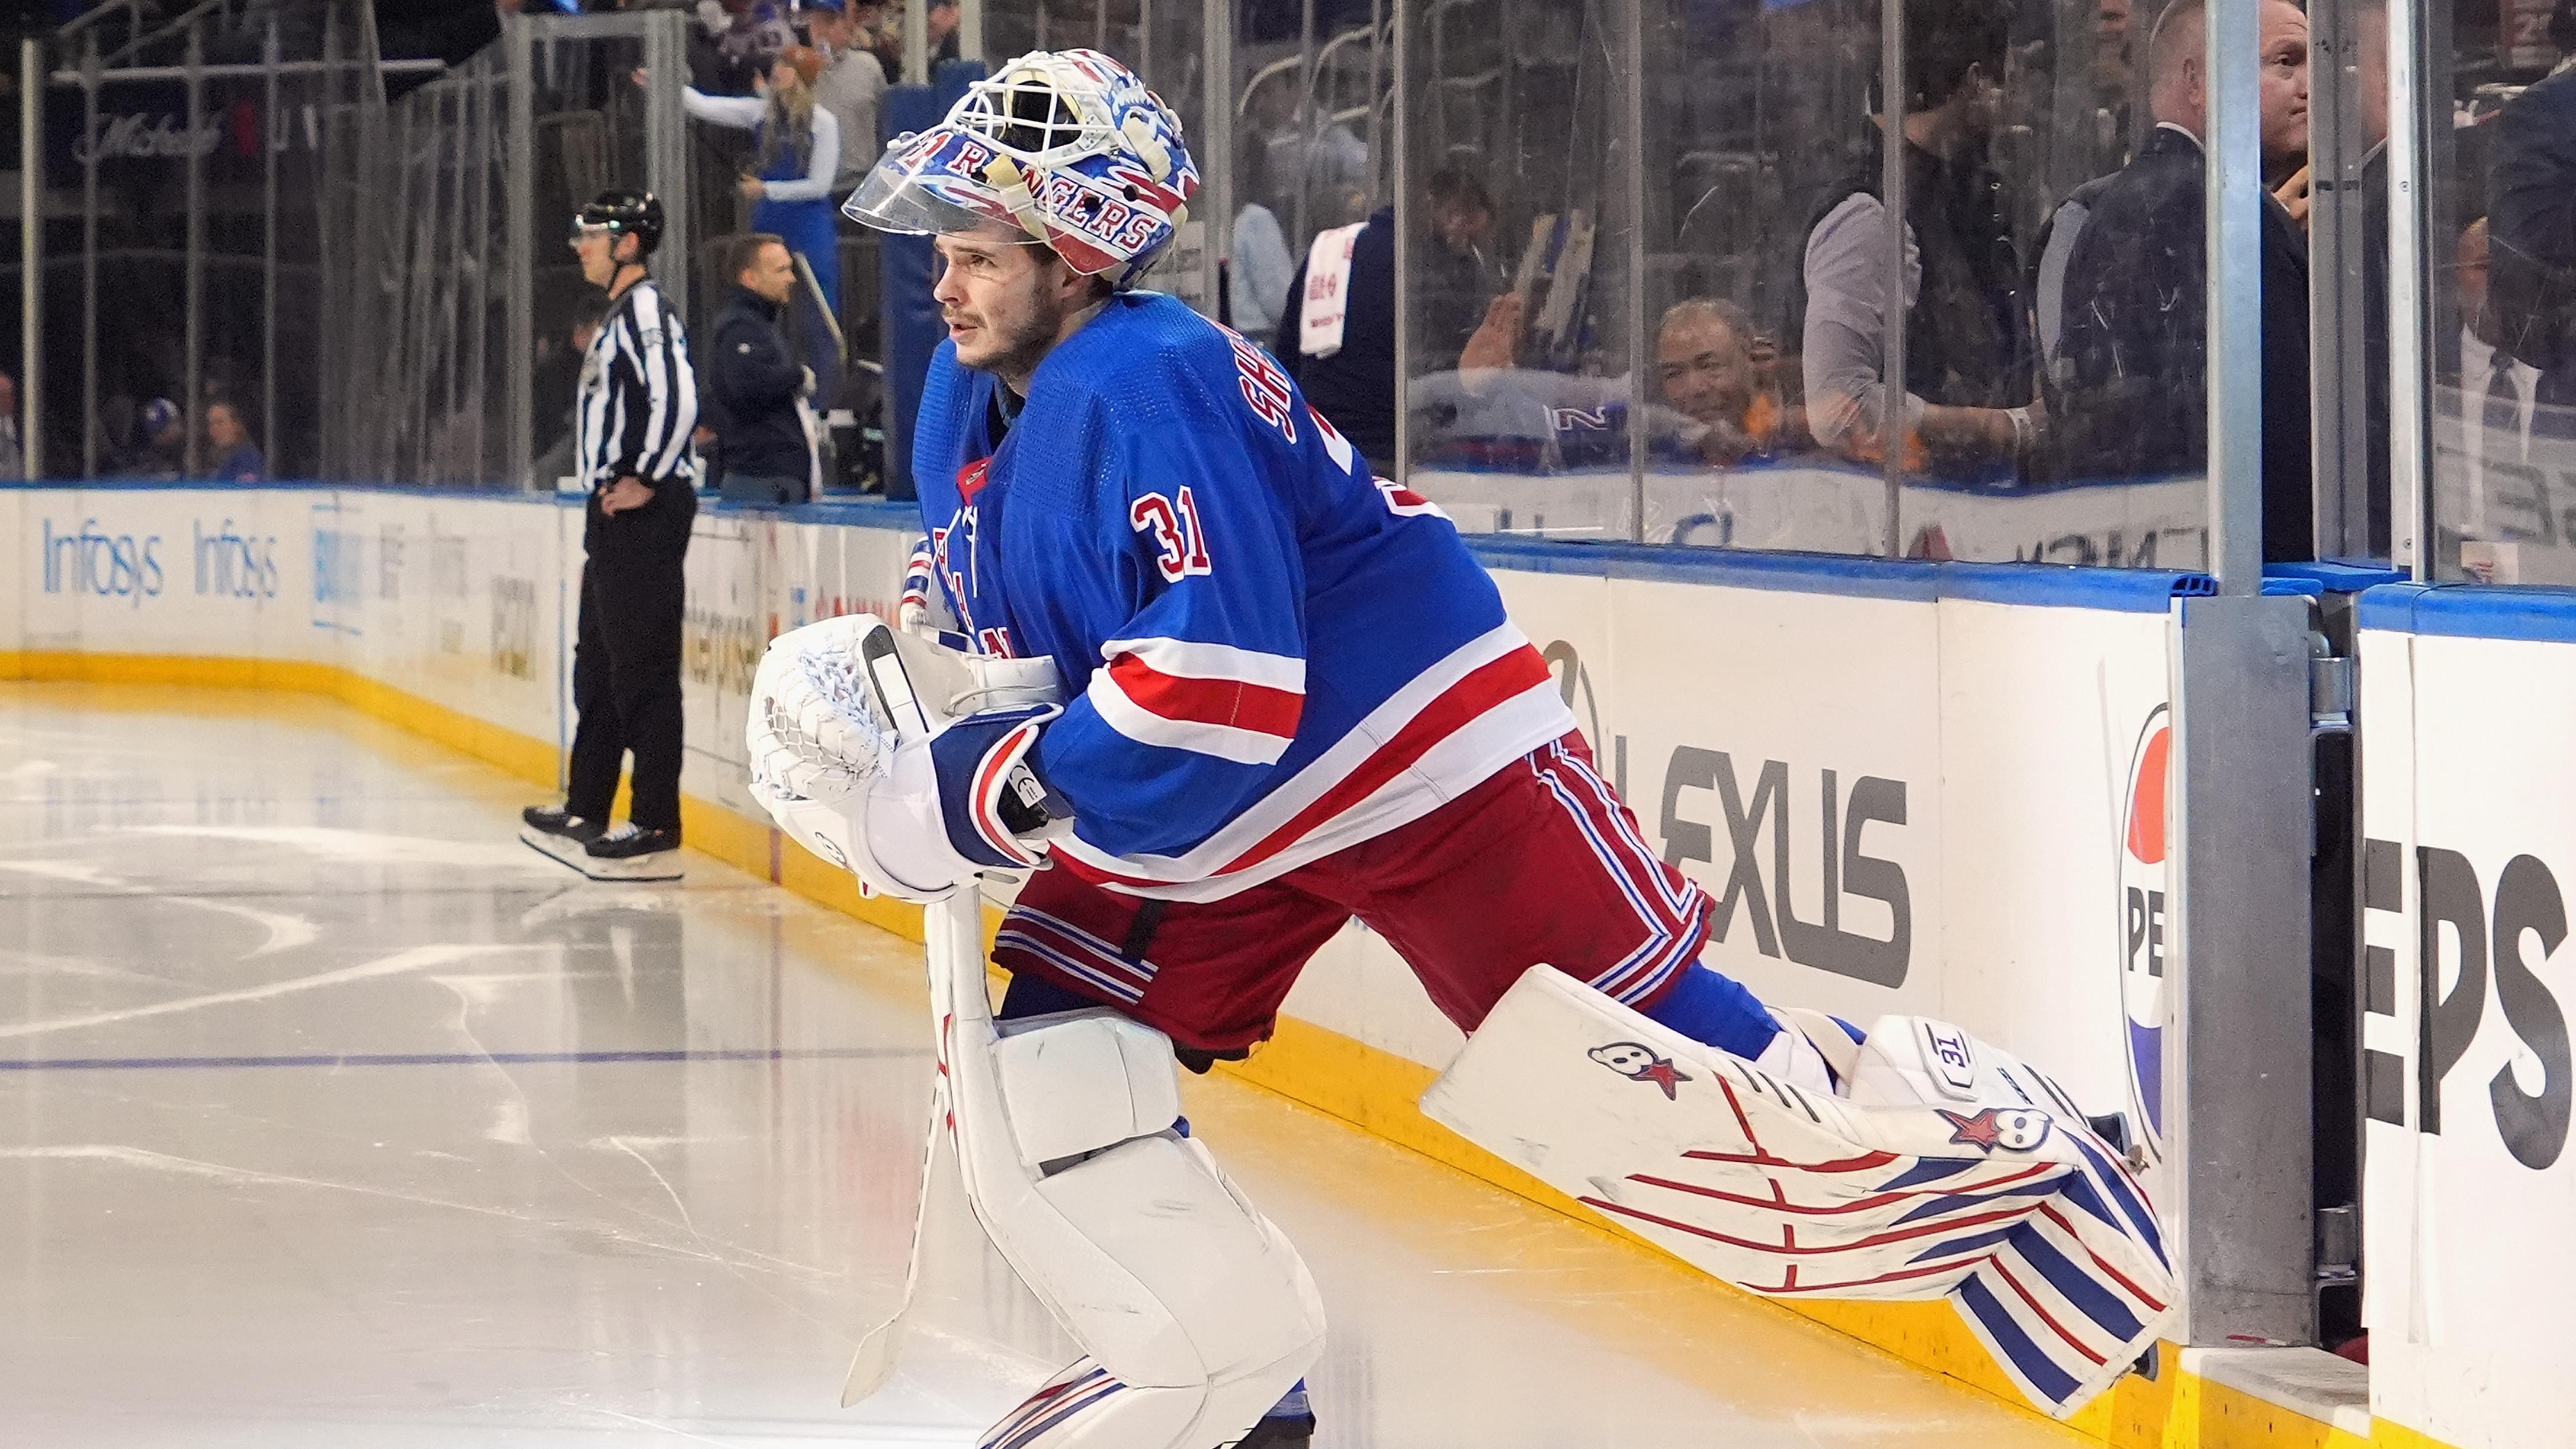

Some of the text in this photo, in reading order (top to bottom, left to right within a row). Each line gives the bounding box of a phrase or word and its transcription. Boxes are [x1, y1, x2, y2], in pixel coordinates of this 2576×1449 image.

[947, 140, 1161, 255] RNGERS
[43, 517, 164, 611] Infosys
[1130, 485, 1212, 583] 31
[1936, 1036, 1967, 1069] 31
